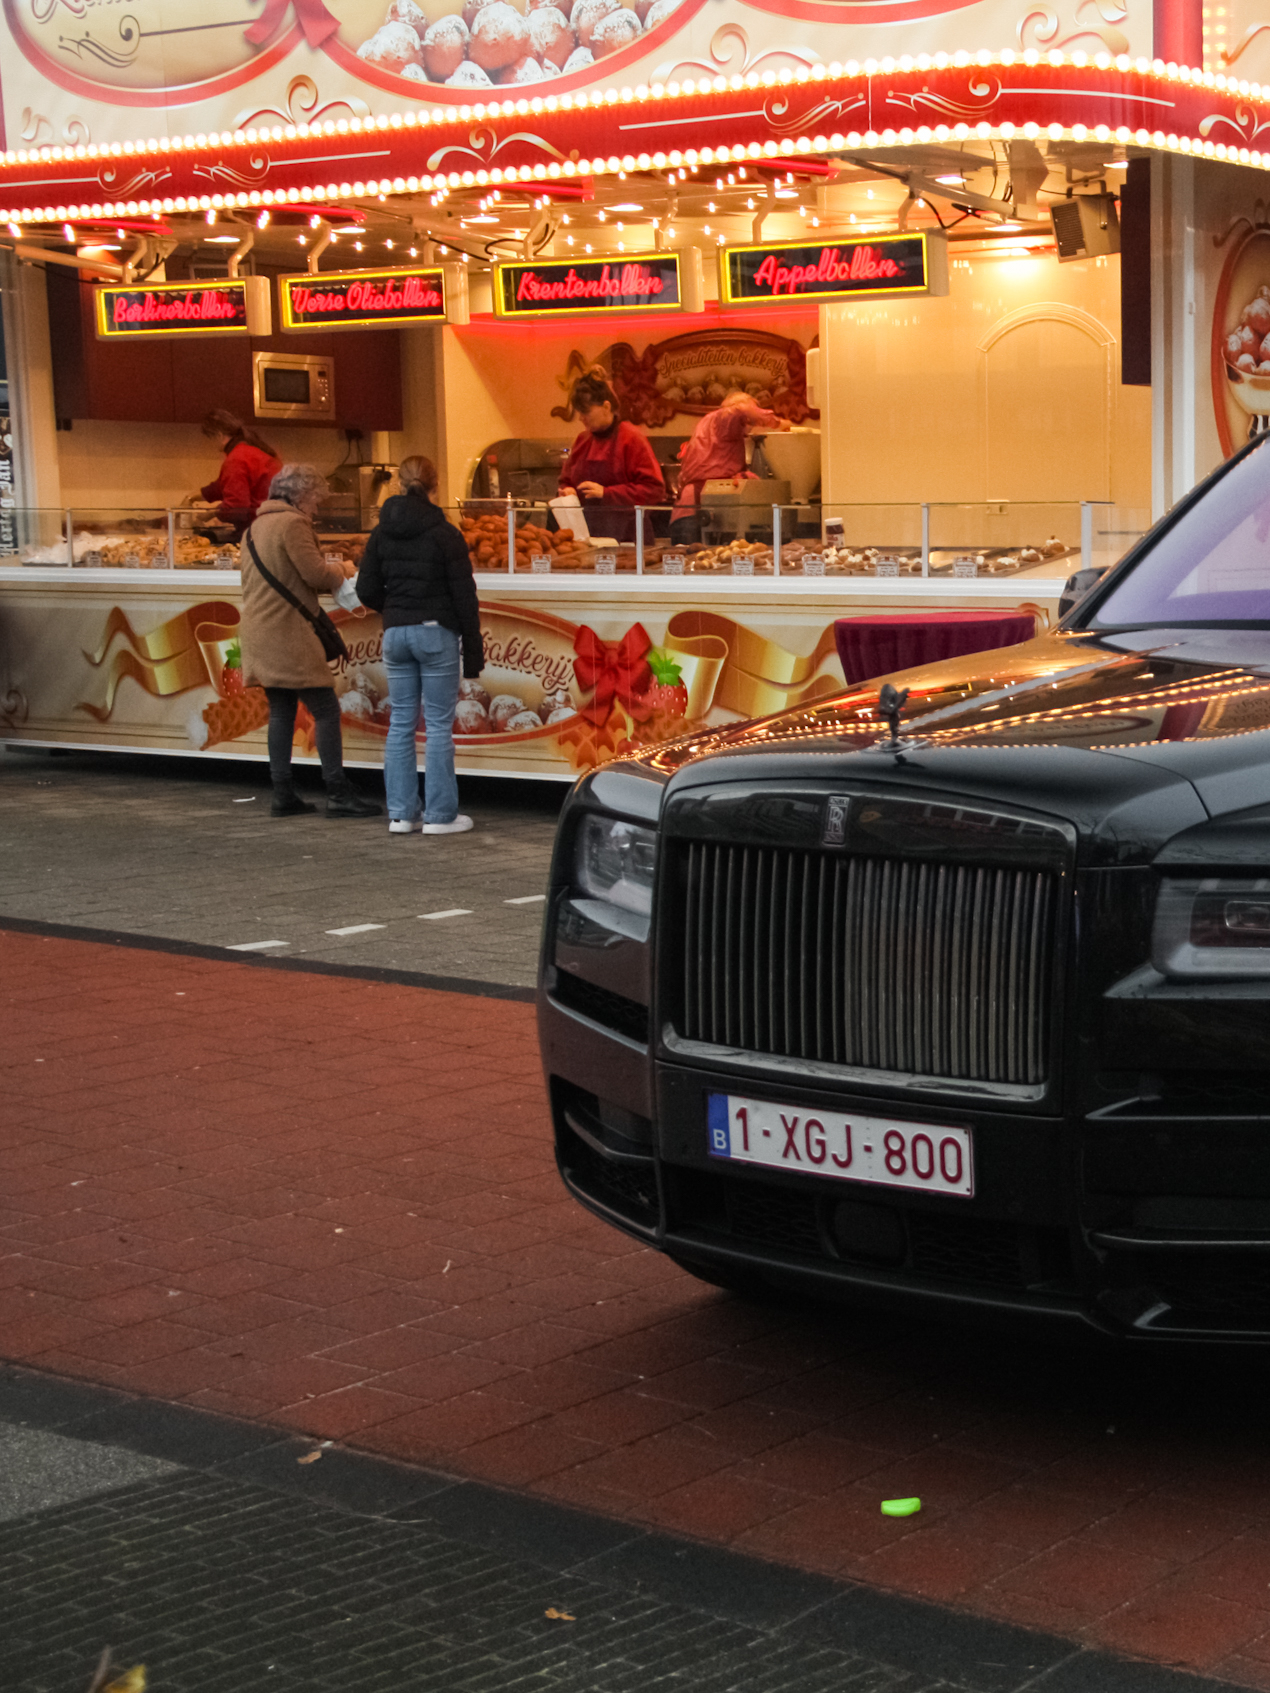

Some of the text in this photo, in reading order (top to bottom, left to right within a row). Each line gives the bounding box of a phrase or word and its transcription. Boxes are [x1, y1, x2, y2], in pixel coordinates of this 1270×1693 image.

[516, 264, 664, 302] Krentenbollen
[753, 246, 899, 295] Appelbollen
[113, 290, 237, 323] Berlinerbollen
[292, 277, 441, 314] Verse Oliebollen
[713, 1106, 963, 1184] B 1-XGJ-800
